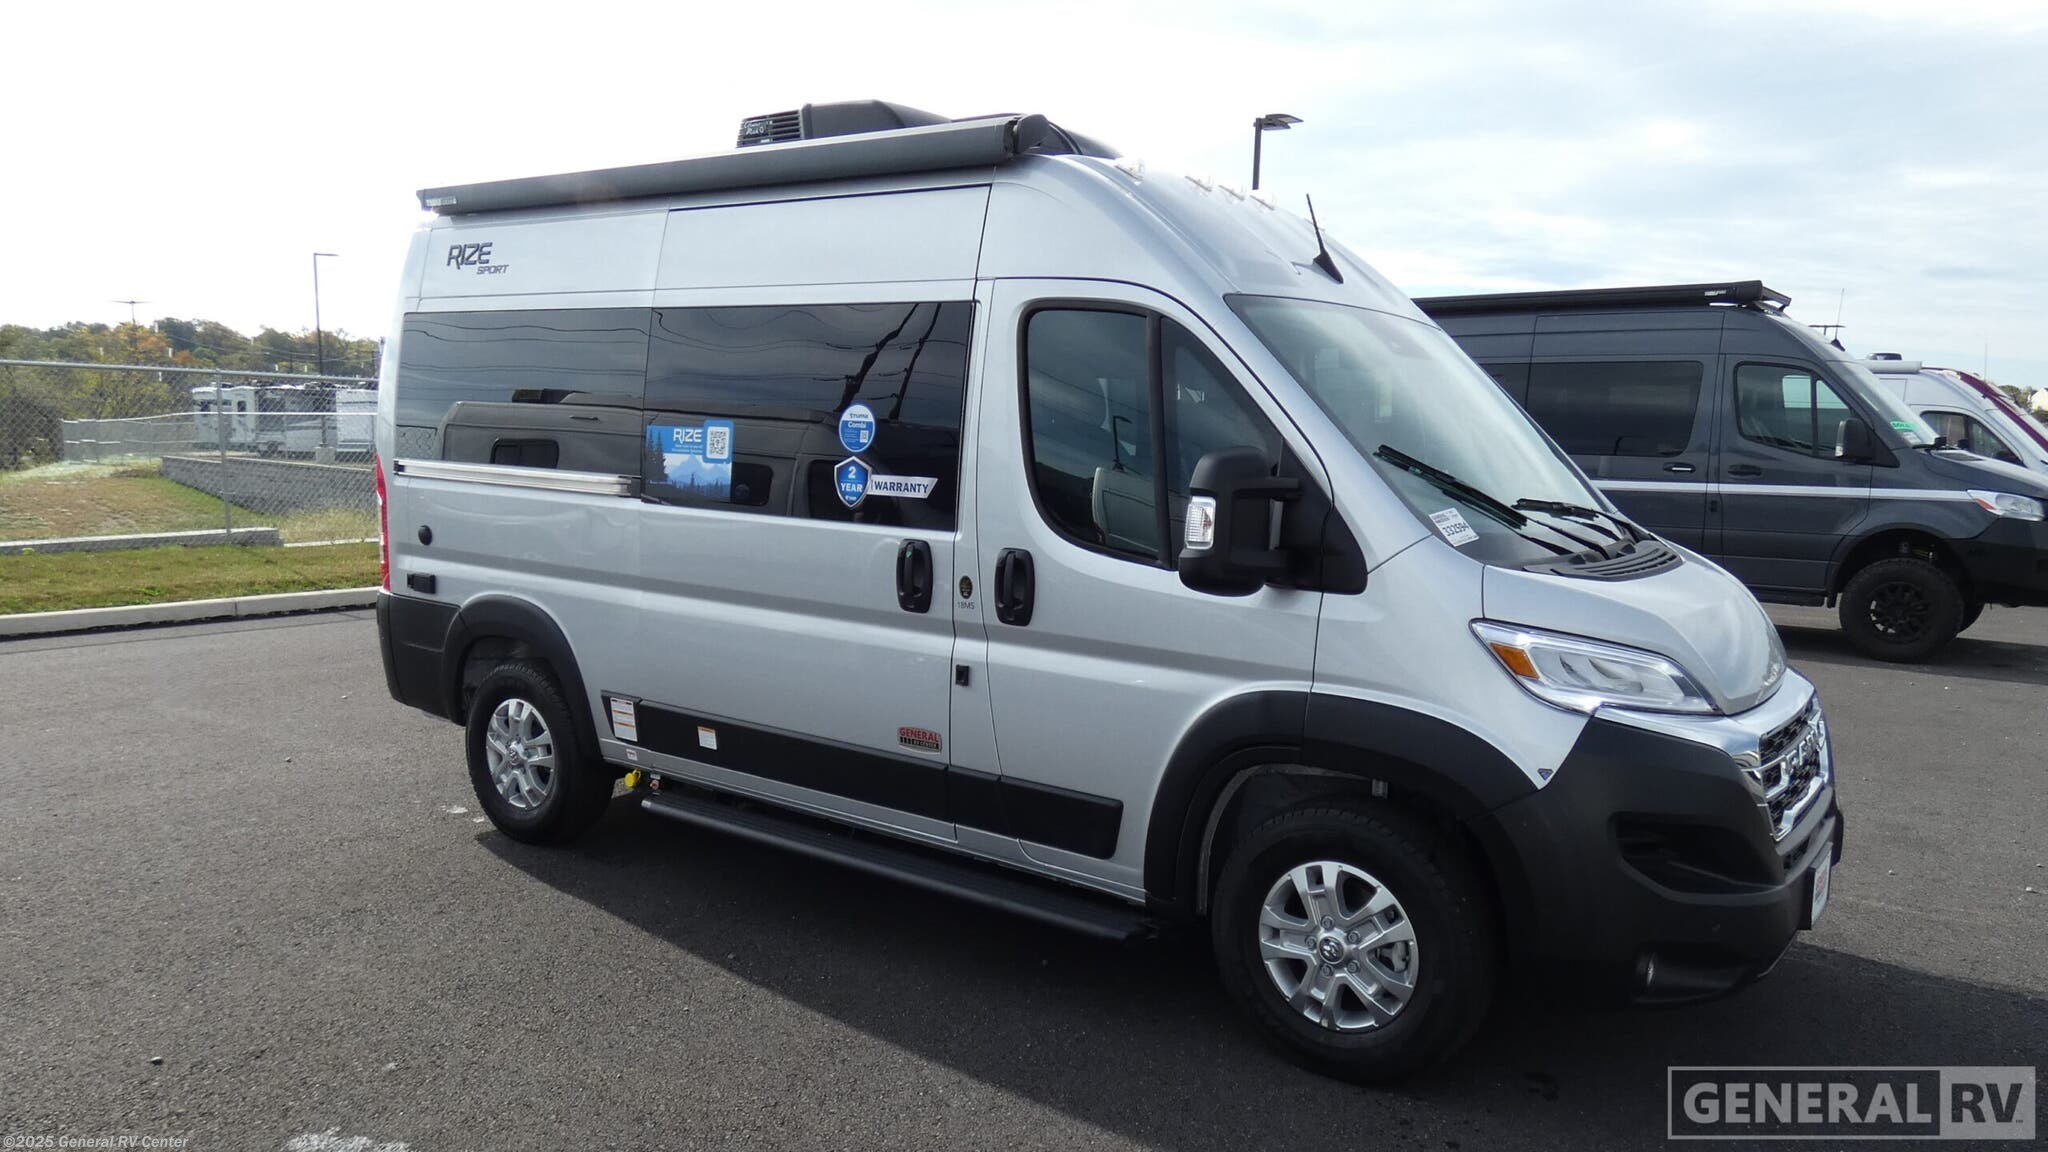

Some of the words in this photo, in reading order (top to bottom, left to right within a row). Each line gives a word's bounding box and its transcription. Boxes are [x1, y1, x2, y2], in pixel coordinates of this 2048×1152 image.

[447, 242, 493, 270] RIZE
[476, 264, 510, 275] SPORT
[847, 421, 867, 429] Combi
[673, 428, 703, 444] RIZE
[848, 466, 857, 479] 2
[840, 482, 863, 493] YEAR
[874, 480, 929, 494] WARRANTY
[899, 727, 940, 743] GENERAL
